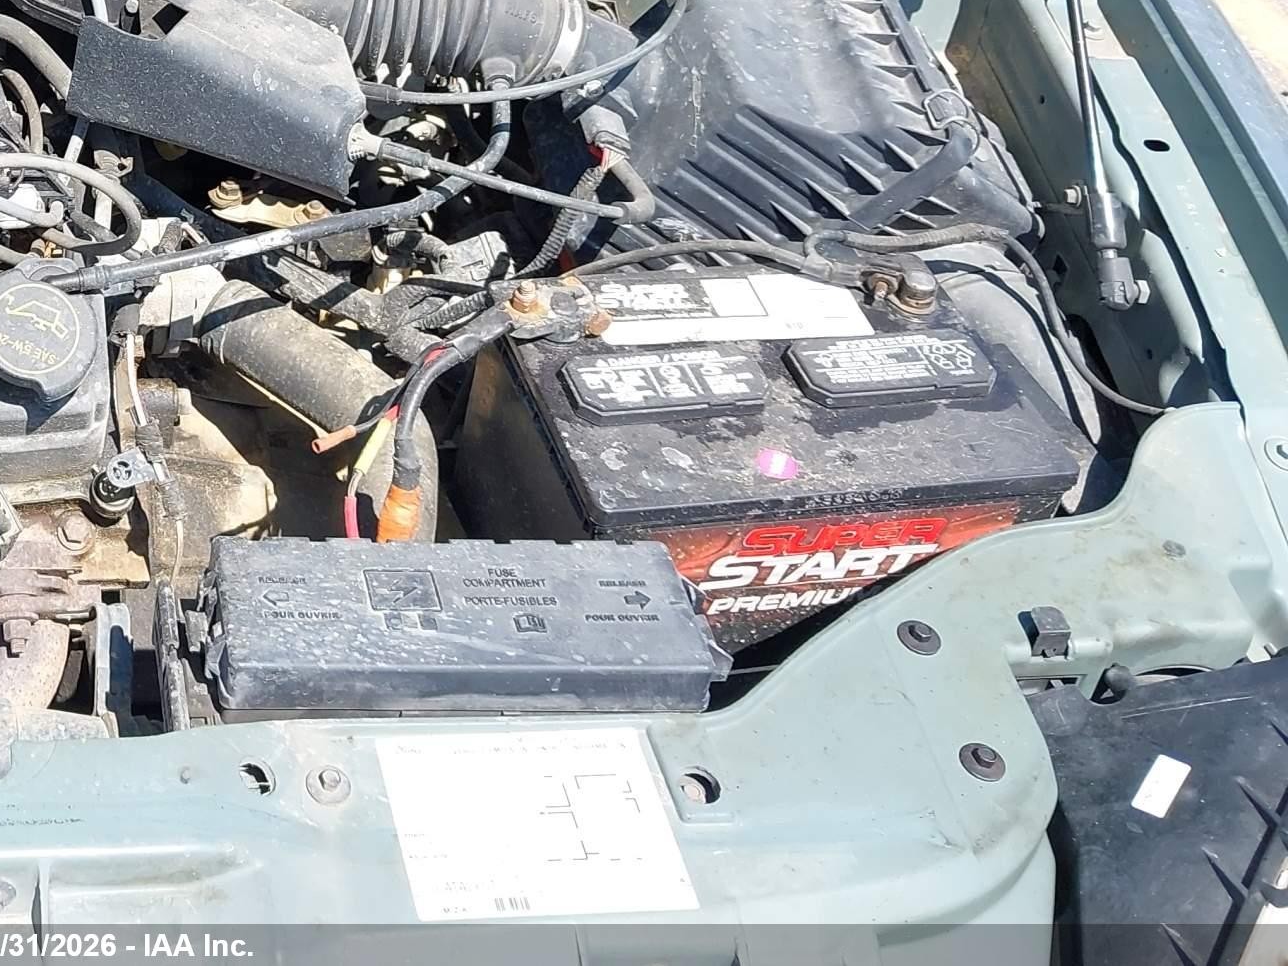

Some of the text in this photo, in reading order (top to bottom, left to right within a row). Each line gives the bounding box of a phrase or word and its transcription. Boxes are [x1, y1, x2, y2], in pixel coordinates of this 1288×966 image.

[32, 347, 58, 364] SAE
[736, 517, 948, 557] SUPER
[487, 568, 517, 578] FUSE
[697, 543, 940, 591] START
[462, 577, 547, 589] COMPARTMENT
[462, 595, 558, 608] PORTE-FUSIBLES
[706, 586, 862, 616] PREMIU
[263, 610, 296, 620] POUR
[584, 613, 660, 623] POUR OUVRIR
